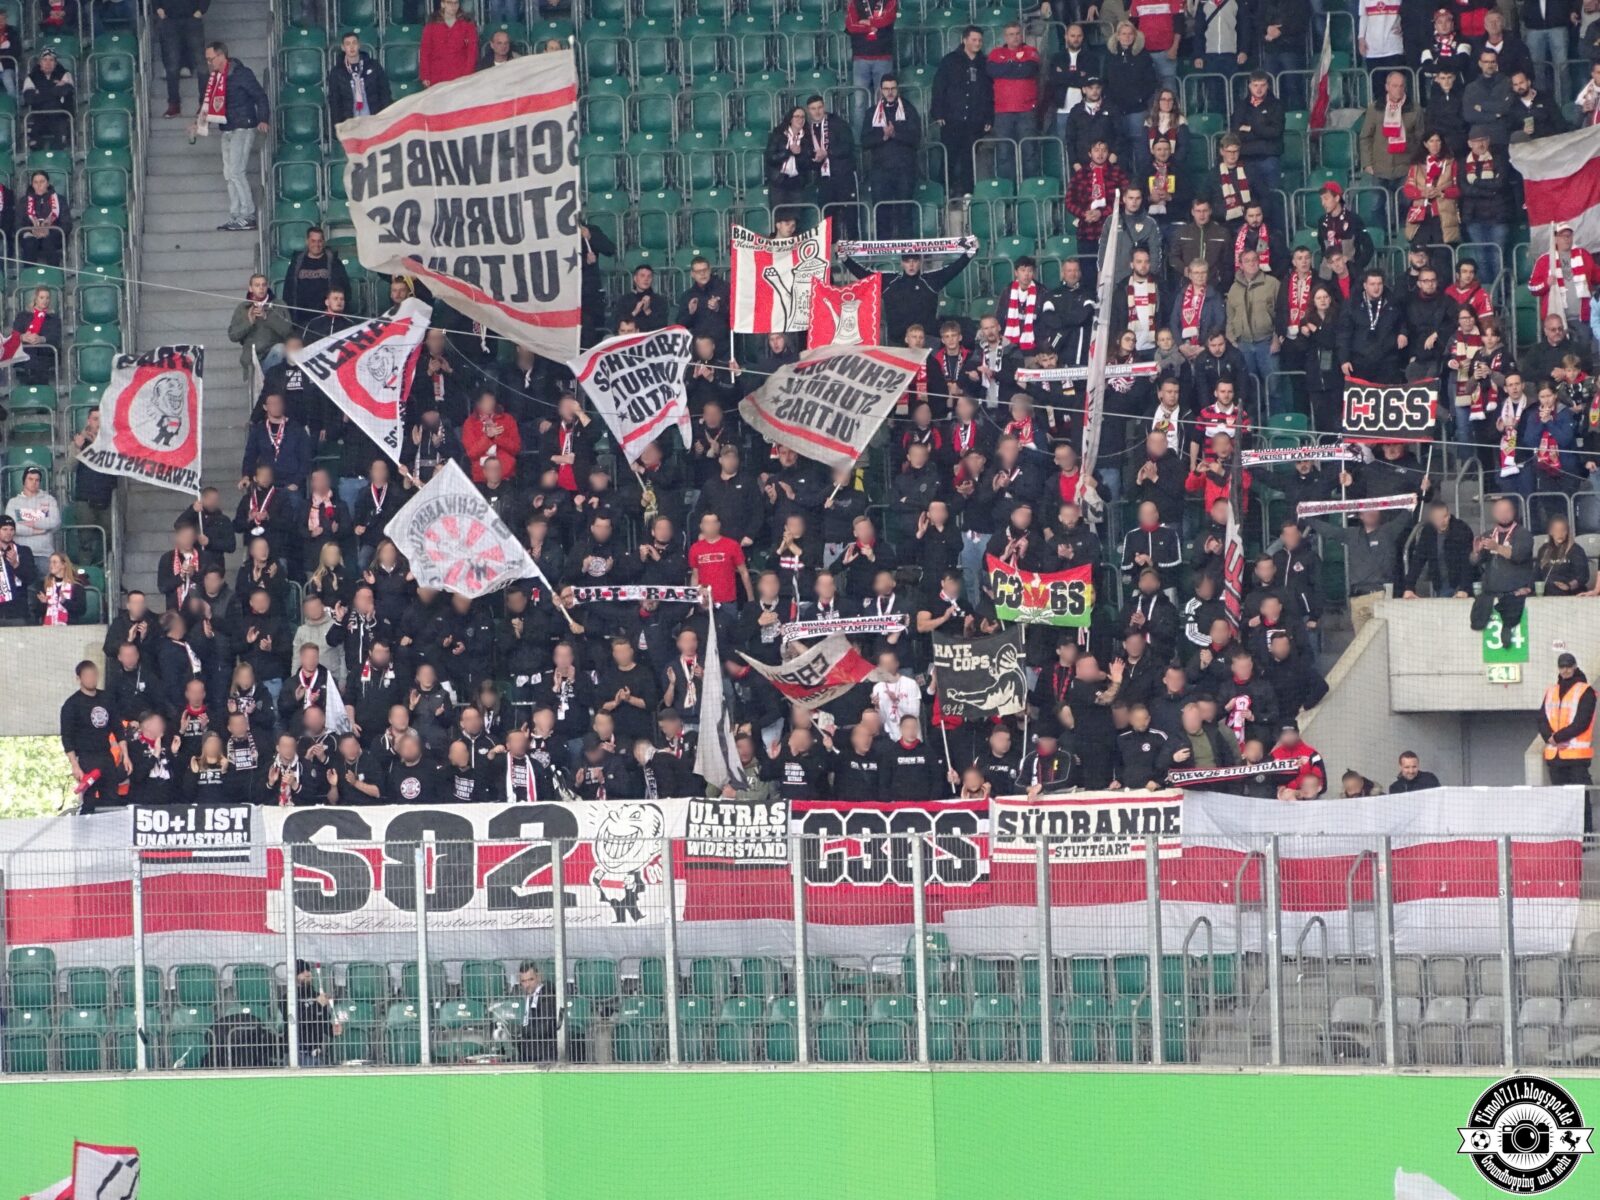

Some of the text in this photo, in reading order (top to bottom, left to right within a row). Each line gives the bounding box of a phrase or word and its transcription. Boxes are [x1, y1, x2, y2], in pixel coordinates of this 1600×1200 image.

[733, 227, 755, 242] BAD
[1345, 386, 1431, 431] C36S
[933, 643, 972, 659] HATE
[953, 655, 990, 672] COPS
[942, 703, 964, 716] 1312
[1172, 770, 1206, 782] CREW
[1223, 759, 1296, 777] STUTTGART
[136, 807, 248, 833] 50+1 IST
[689, 801, 787, 827] ULTRAS
[997, 806, 1181, 844] SÜDBANDE
[136, 832, 248, 847] UNANTASTBAR!
[801, 808, 982, 887] C36S
[686, 840, 788, 859] WIDERSTAND
[1055, 843, 1131, 858] STUTTGART
